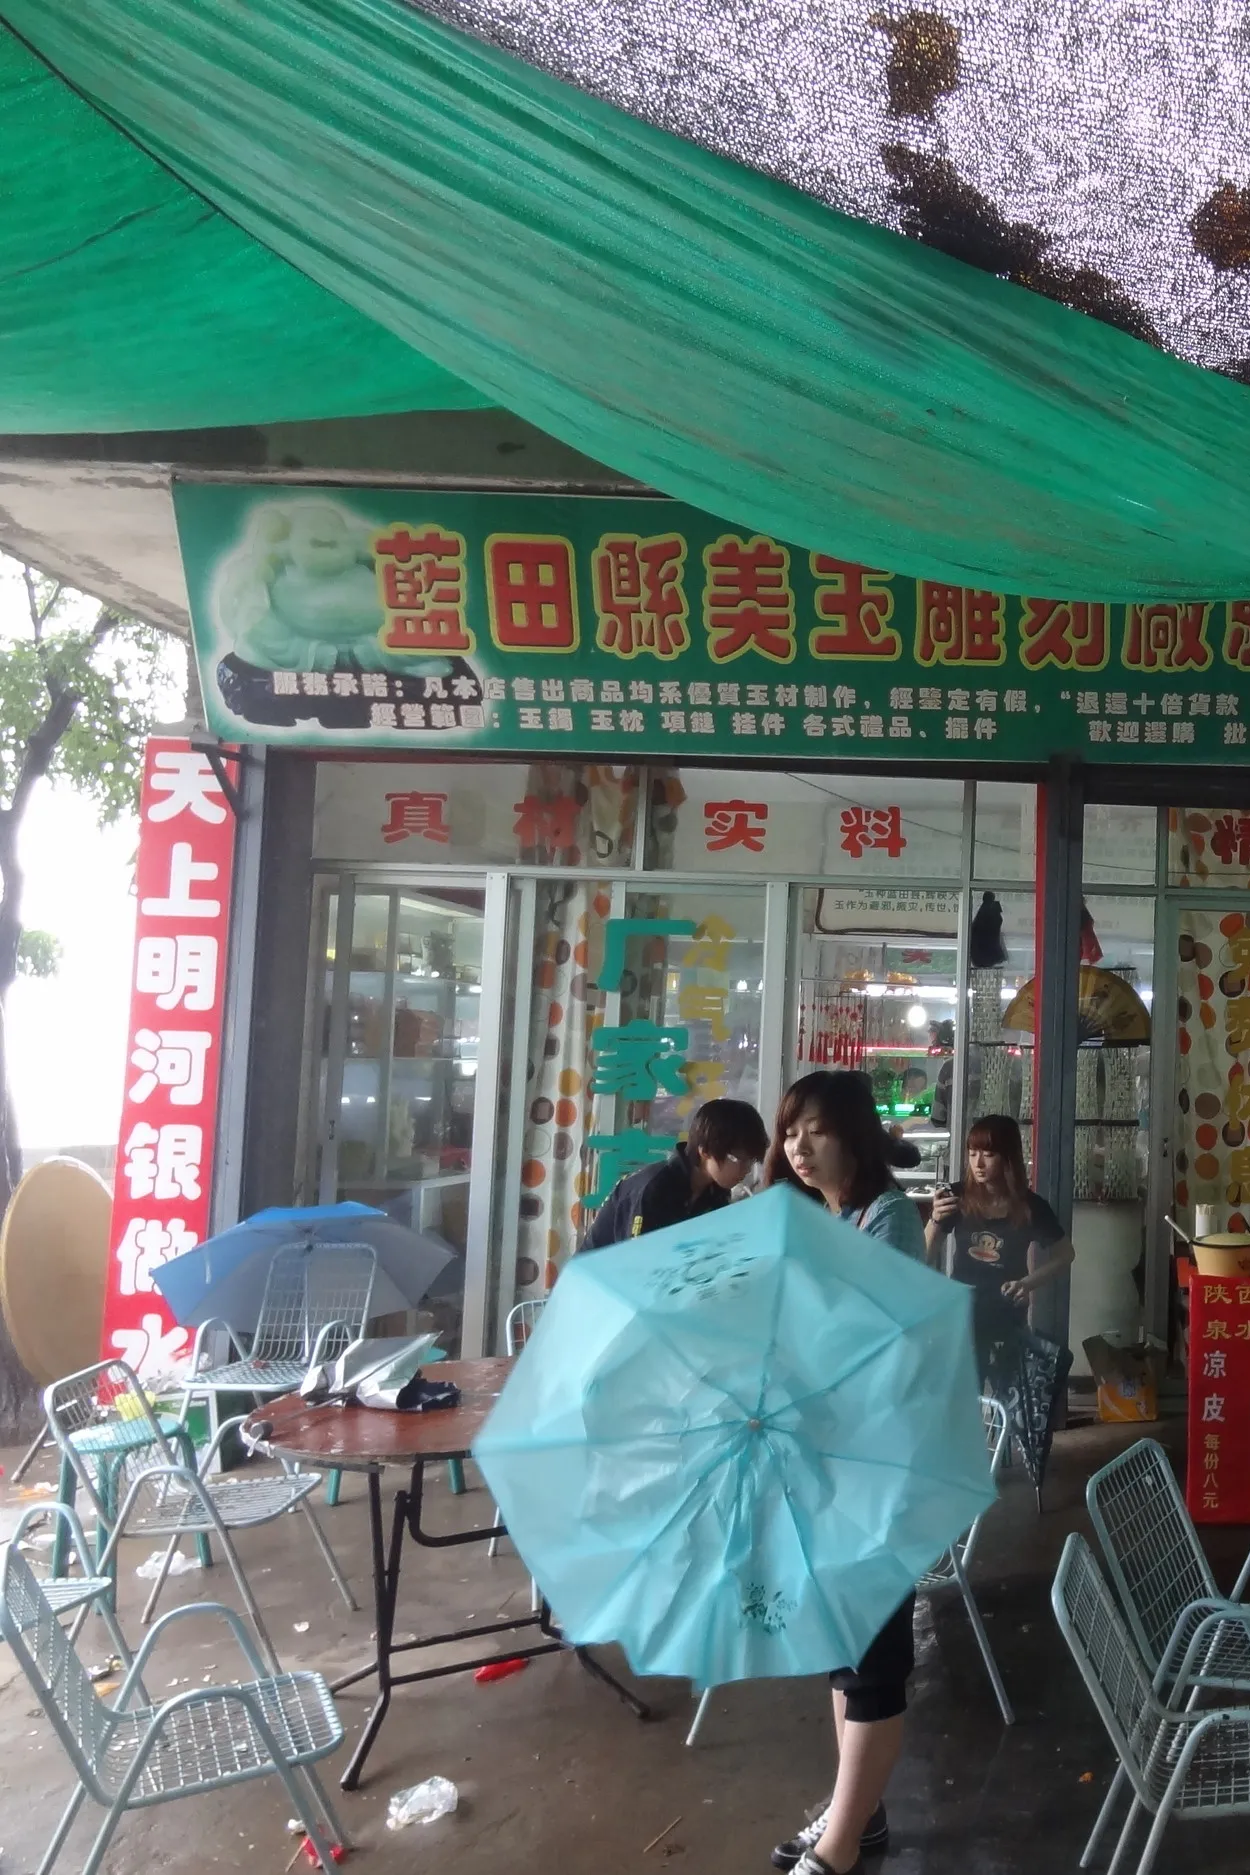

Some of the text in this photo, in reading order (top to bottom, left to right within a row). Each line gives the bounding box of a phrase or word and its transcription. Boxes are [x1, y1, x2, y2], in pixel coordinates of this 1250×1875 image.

[381, 790, 907, 860] 真材实料
[1201, 1349, 1228, 1424] 凉皮
[1202, 1433, 1221, 1510] 每份八元
